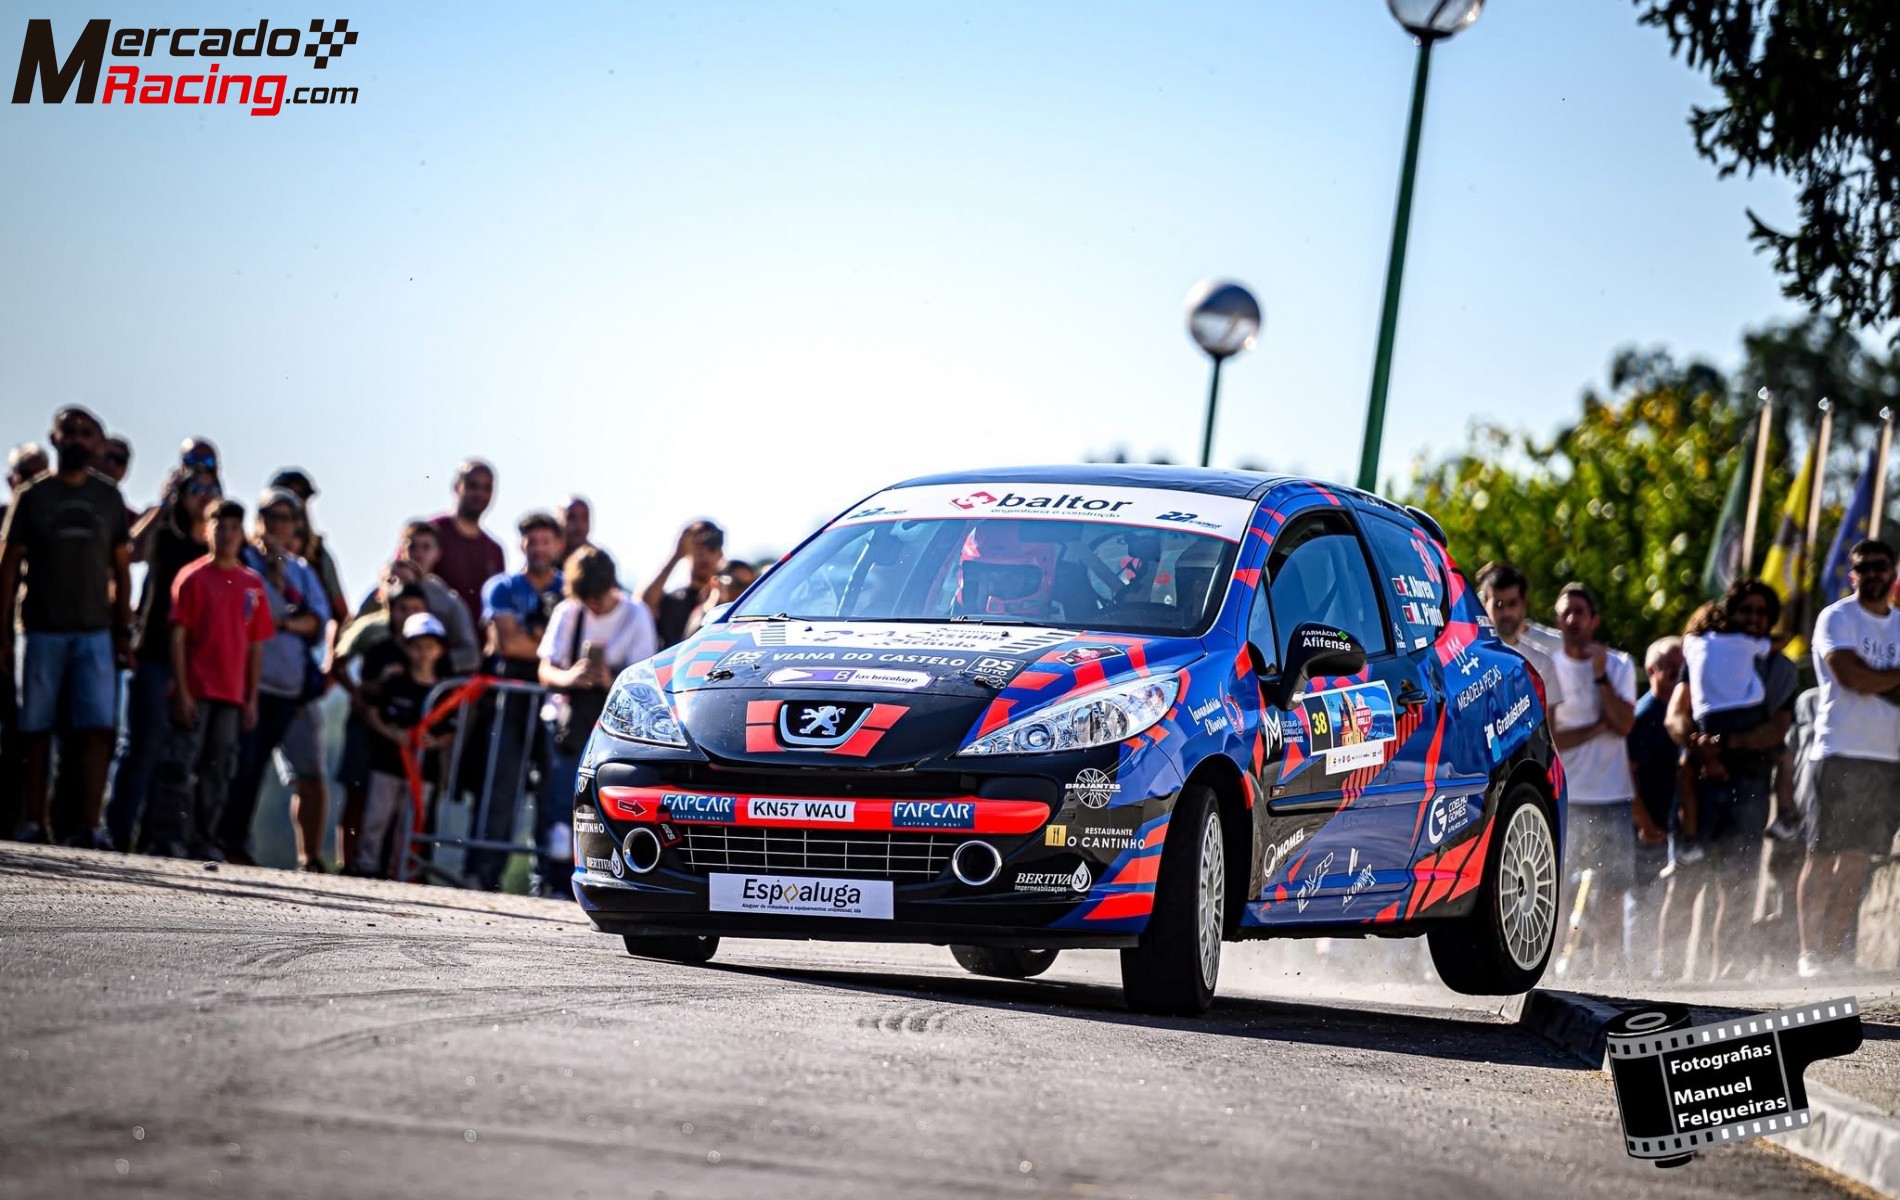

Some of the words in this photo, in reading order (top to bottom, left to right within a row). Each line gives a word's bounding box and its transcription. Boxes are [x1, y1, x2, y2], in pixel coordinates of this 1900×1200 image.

[997, 493, 1133, 511] baltor
[1421, 603, 1444, 627] Pinto
[1303, 637, 1351, 651] Afifense
[772, 653, 835, 661] VIANA
[841, 653, 874, 661] DO
[878, 654, 966, 666] CASTELO
[978, 658, 1017, 671] DS
[974, 667, 1008, 676] AUTO
[871, 675, 918, 683] bricolage
[1312, 711, 1328, 735] 38
[664, 795, 731, 812] FAPCAR
[754, 802, 799, 816] KN57
[805, 803, 847, 818] WAU
[894, 803, 969, 818] FAPCAR
[1085, 827, 1133, 835] RESTAURANTE
[1067, 836, 1077, 846] O
[1081, 837, 1145, 849] CANTINHO
